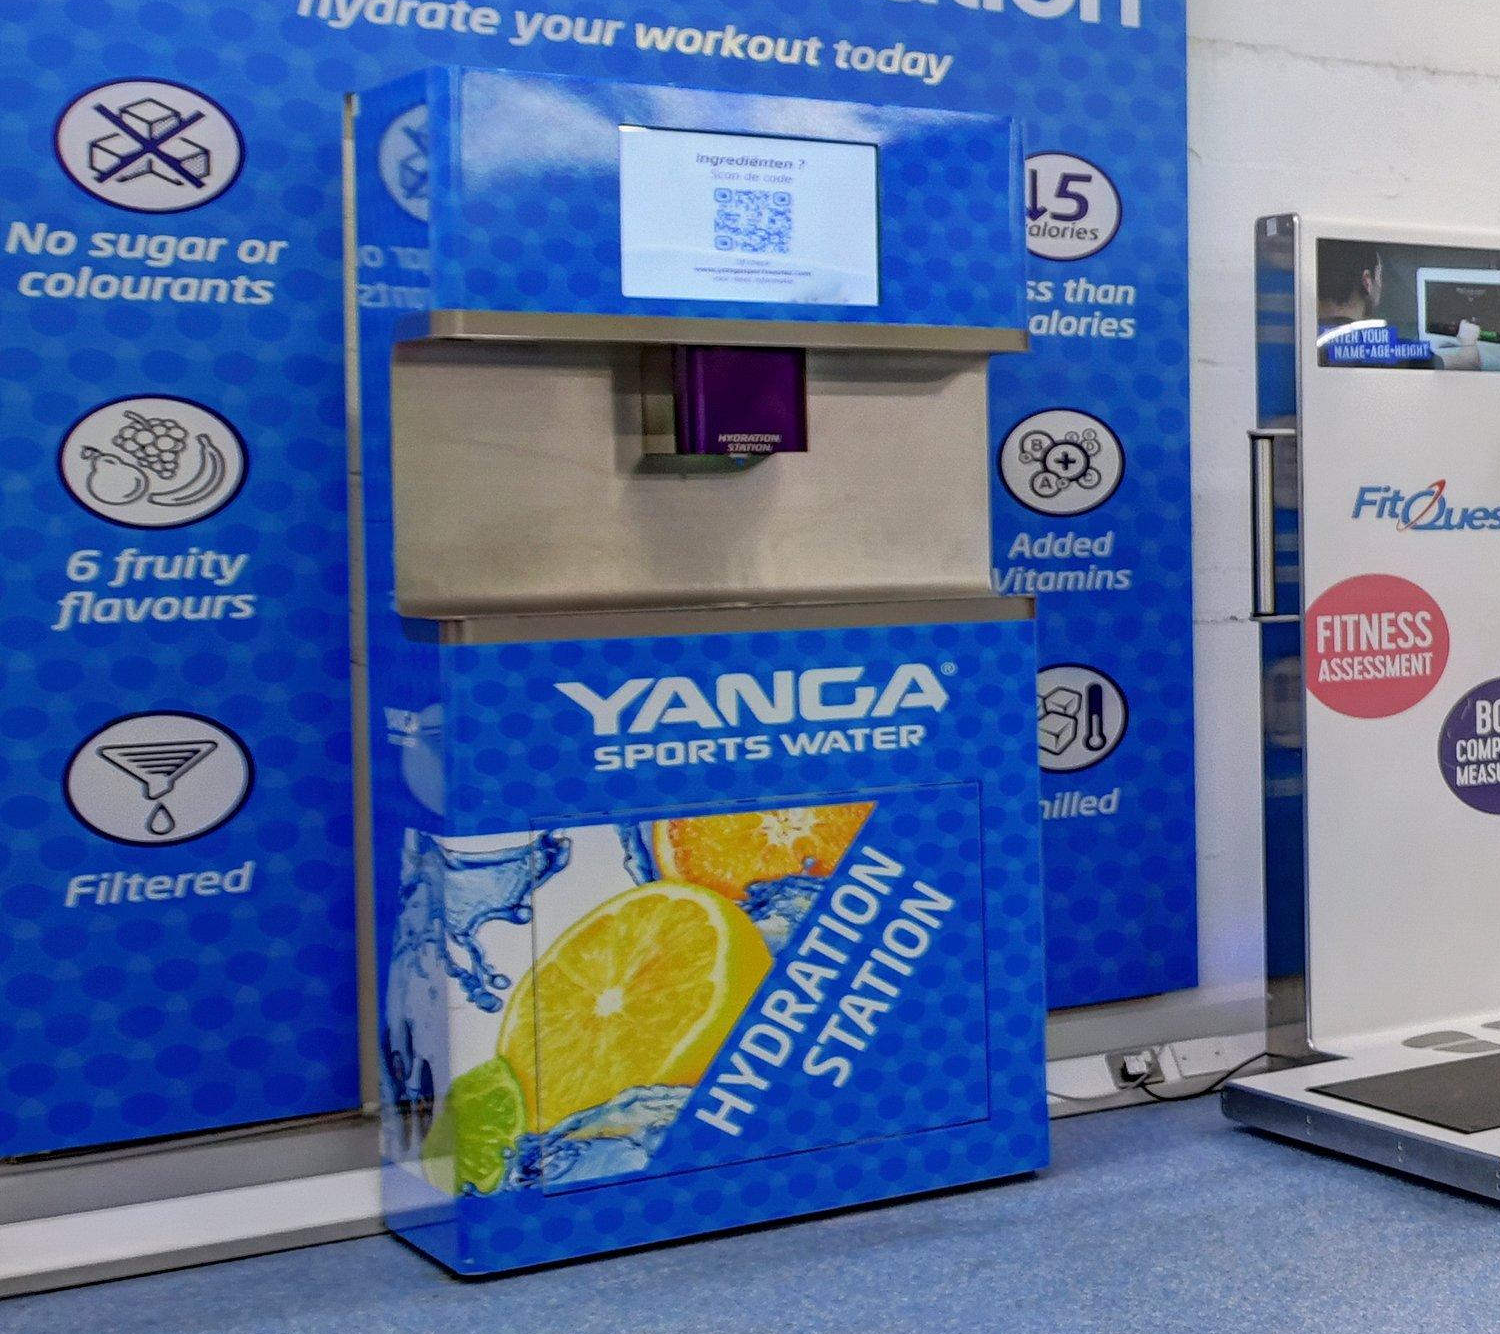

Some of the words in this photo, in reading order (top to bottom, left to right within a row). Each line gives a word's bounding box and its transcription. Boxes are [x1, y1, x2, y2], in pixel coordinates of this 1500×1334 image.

[508, 7, 625, 46] your
[635, 21, 821, 66] workout
[834, 40, 952, 86] today
[763, 173, 793, 184] code
[1051, 172, 1093, 222] 5
[5, 221, 77, 256] No
[88, 231, 229, 267] sugar
[237, 238, 289, 265] or
[1026, 222, 1099, 241] alories
[17, 266, 276, 305] colourants
[1026, 280, 1054, 301] ss
[1064, 277, 1137, 305] than
[1028, 309, 1137, 339] alories
[1362, 328, 1389, 344] YOUR
[718, 434, 781, 443] HYDRATION
[726, 443, 773, 452] STATION
[1007, 531, 1114, 559] Added
[66, 549, 103, 582] 6
[107, 547, 250, 588] fruity
[990, 564, 1134, 593] Vitamins
[51, 591, 258, 632] flavours
[1316, 610, 1433, 653] FITNESS
[1317, 652, 1433, 682] ASSESSMENT
[553, 662, 949, 736] YANGA
[594, 734, 772, 771] SPORTS
[779, 723, 927, 756] WATER
[1038, 787, 1121, 820] illed
[64, 862, 254, 909] Filtered
[695, 845, 905, 1137] HYDRATION
[802, 879, 956, 1088] STATION
